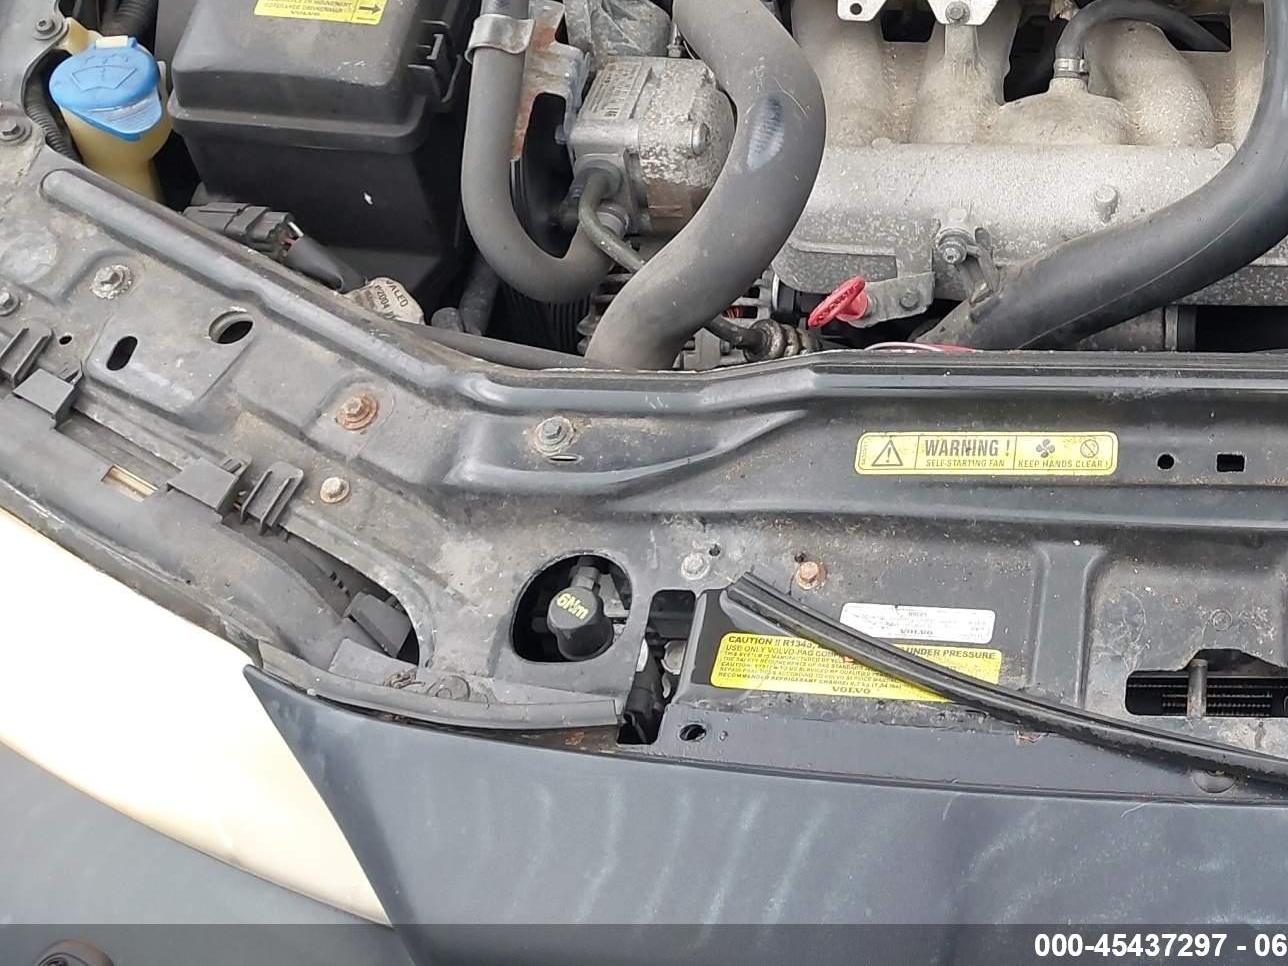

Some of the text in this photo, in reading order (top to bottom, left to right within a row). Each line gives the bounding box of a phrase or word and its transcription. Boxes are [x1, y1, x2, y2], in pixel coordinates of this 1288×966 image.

[386, 280, 409, 308] VALEO
[924, 439, 1011, 457] WARNING !
[925, 458, 1005, 468] SELF-STARTING FAN
[1018, 459, 1040, 468] KEEP
[1042, 459, 1073, 468] HANDS
[1075, 459, 1103, 468] CLEAR
[556, 593, 589, 620] 6Nm
[725, 644, 742, 652] USE
[744, 645, 767, 654] ONLY
[728, 636, 773, 646] CAUTION
[907, 647, 941, 657] UNDER
[942, 649, 996, 660] PRESSURE
[832, 686, 871, 695] VOLVO
